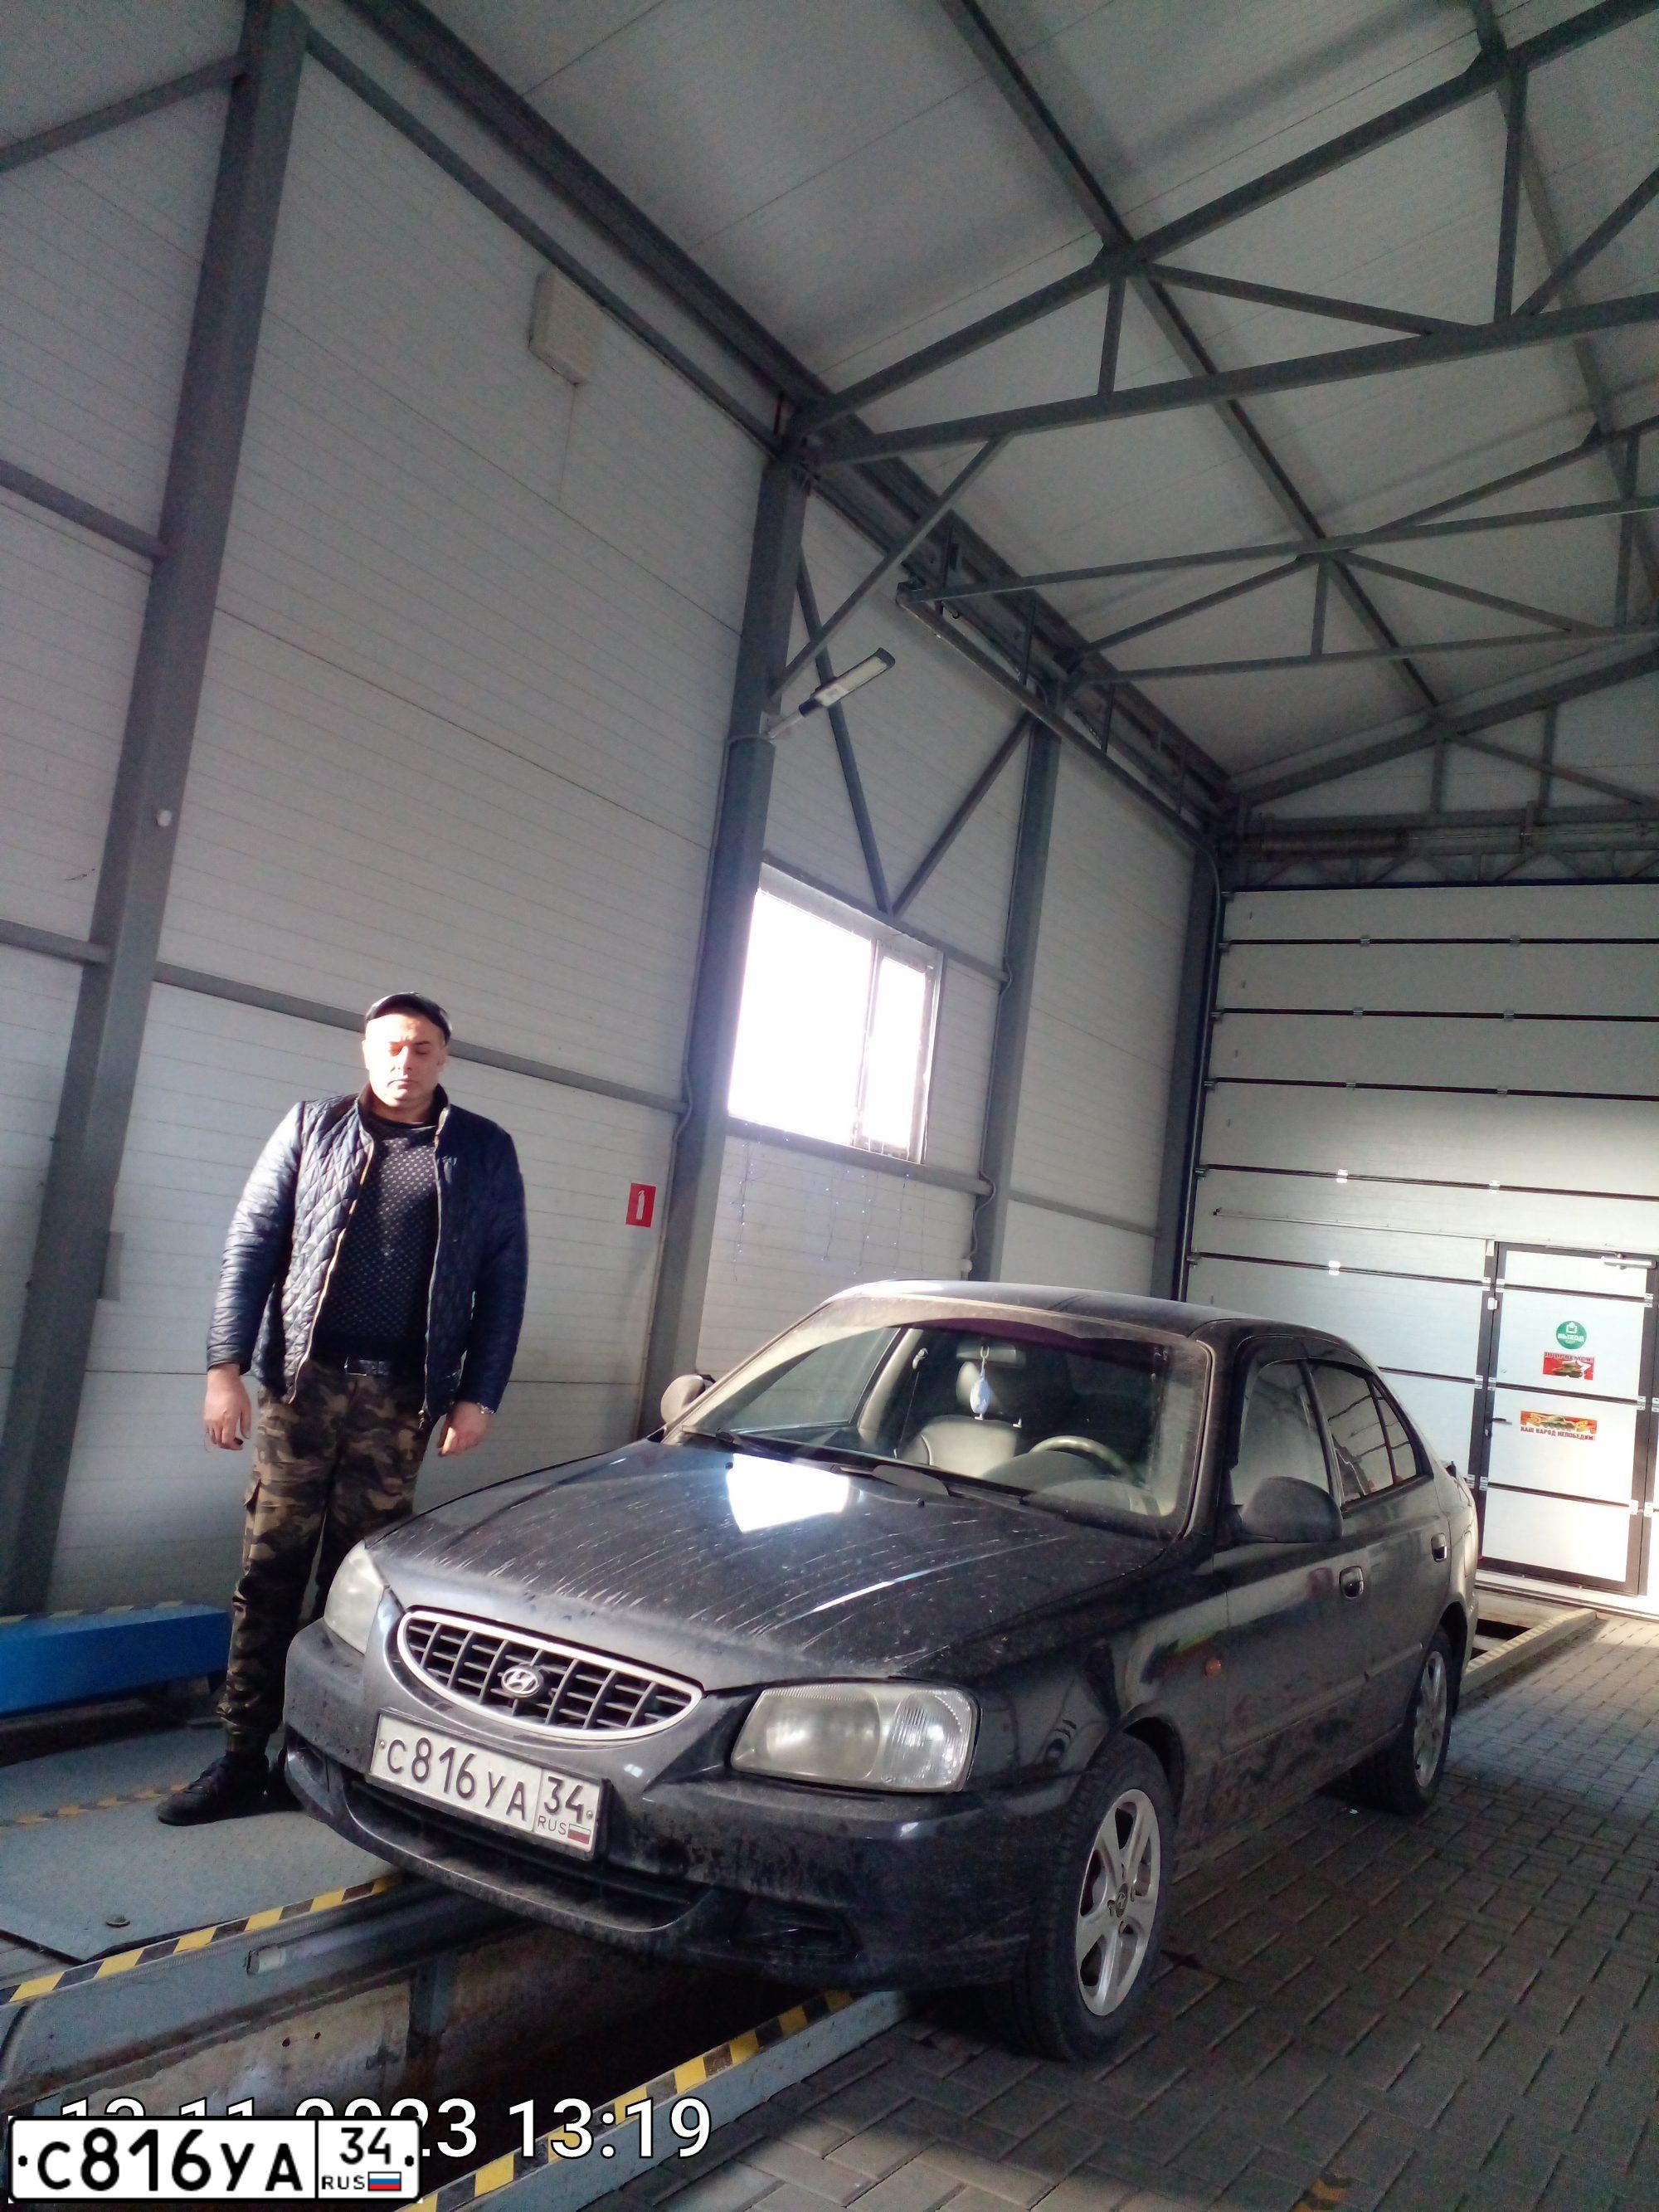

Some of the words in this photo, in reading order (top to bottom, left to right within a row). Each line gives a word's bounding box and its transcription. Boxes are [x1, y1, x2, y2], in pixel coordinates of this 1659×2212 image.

[1535, 1428, 1555, 1436] НАРОД
[387, 1737, 528, 1821] С816УА
[543, 1776, 585, 1824] 34
[538, 1815, 567, 1835] RUS
